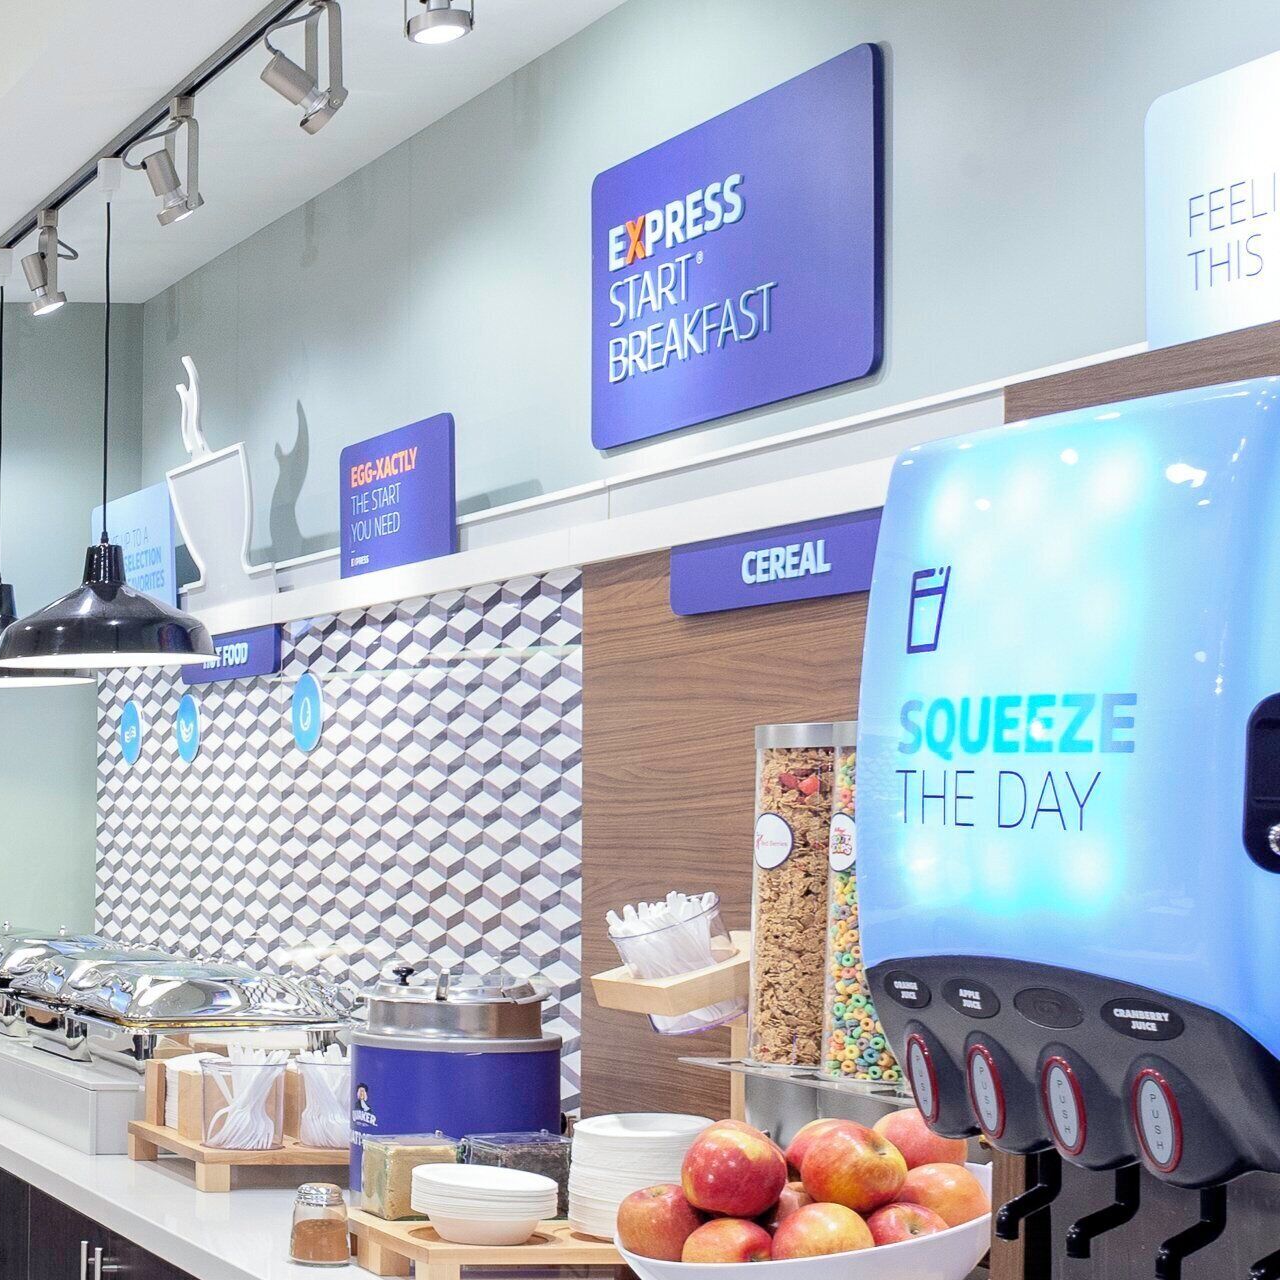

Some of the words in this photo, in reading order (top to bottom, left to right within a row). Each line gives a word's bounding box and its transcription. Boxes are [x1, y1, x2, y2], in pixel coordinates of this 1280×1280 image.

[608, 173, 745, 273] EXPRESS
[1187, 233, 1264, 291] THIS
[608, 281, 779, 385] BREAKFAST
[350, 446, 418, 489] EGG-XACTLY
[350, 491, 370, 516] THE
[371, 482, 402, 512] START
[350, 518, 372, 543] YOU
[374, 512, 401, 538] NEED
[741, 539, 833, 585] CEREAL
[222, 642, 249, 667] FOOD
[897, 692, 1139, 761] SQUEEZE
[895, 769, 975, 827] THE
[997, 770, 1102, 832] DAY
[900, 990, 918, 1000] JUICE
[958, 988, 981, 1000] APPLE
[961, 999, 983, 1010] JUICE
[1112, 1008, 1170, 1022] CRANBERRY
[1130, 1020, 1159, 1032] JUICE
[1056, 1079, 1072, 1135] PUSH
[1149, 1093, 1165, 1151] PUSH
